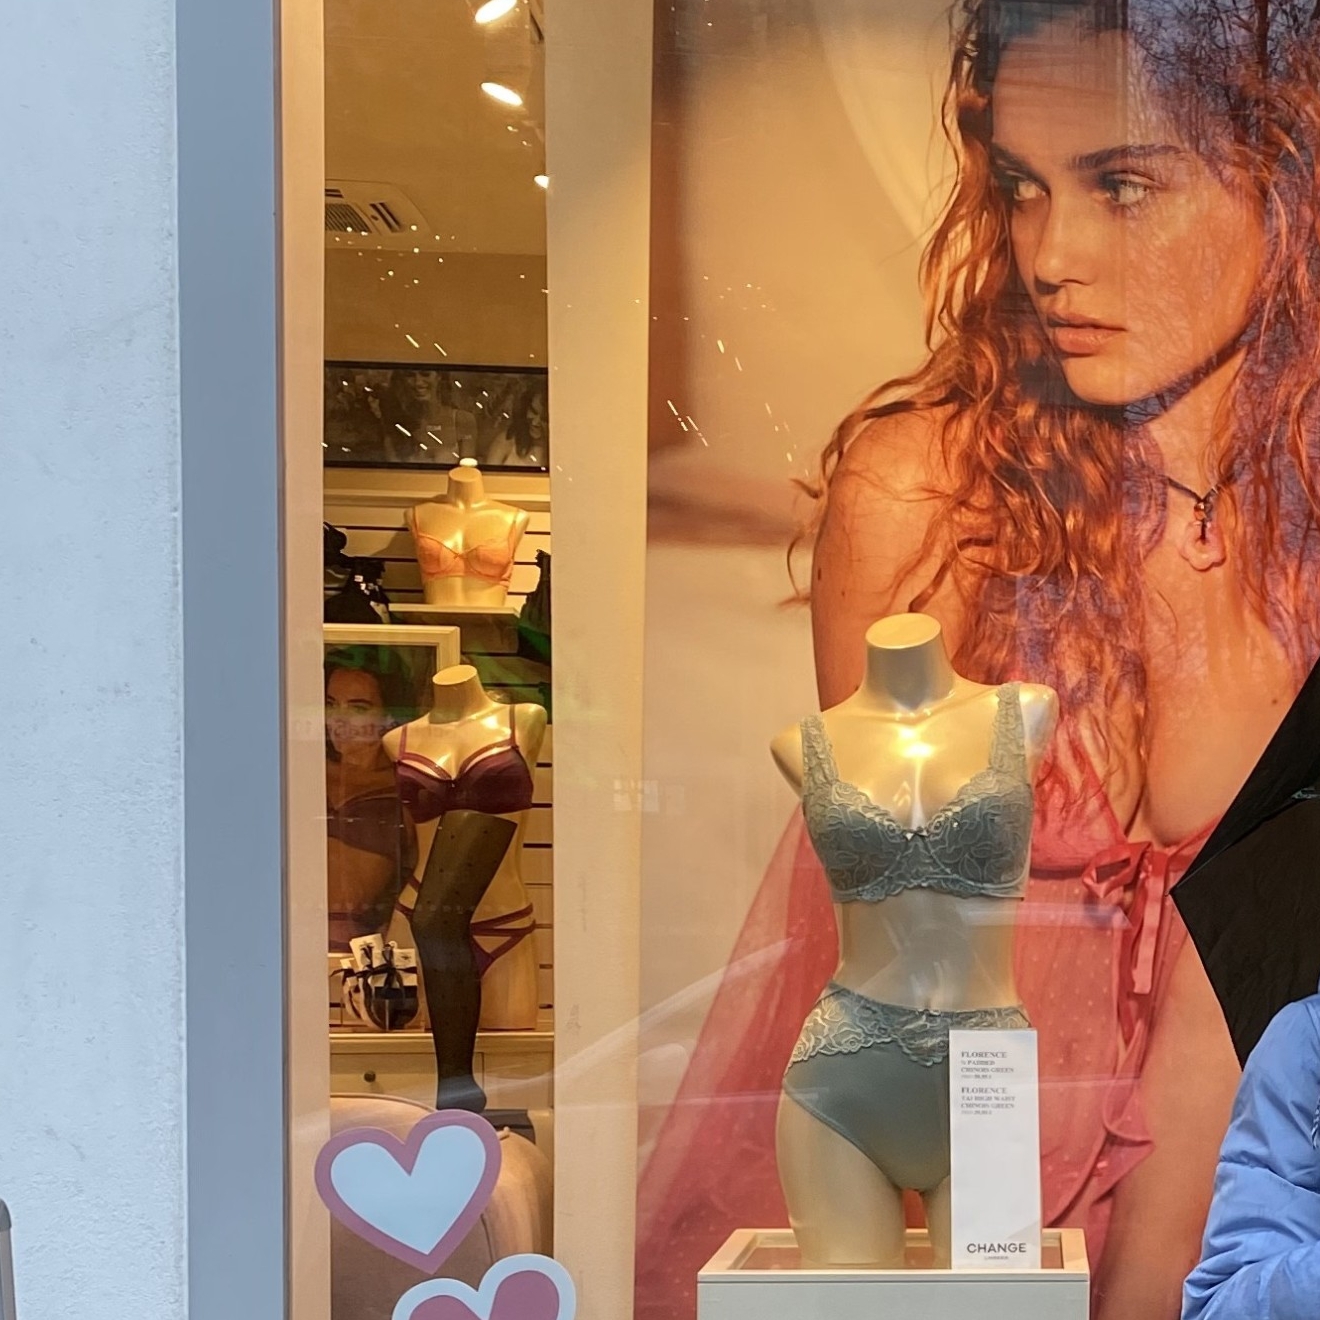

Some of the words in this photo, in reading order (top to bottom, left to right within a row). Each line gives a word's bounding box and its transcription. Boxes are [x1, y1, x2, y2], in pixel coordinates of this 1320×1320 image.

[961, 1051, 1007, 1059] FLORENCE
[961, 1087, 1007, 1095] FLORENCE
[966, 1242, 1027, 1254] CHANGE
